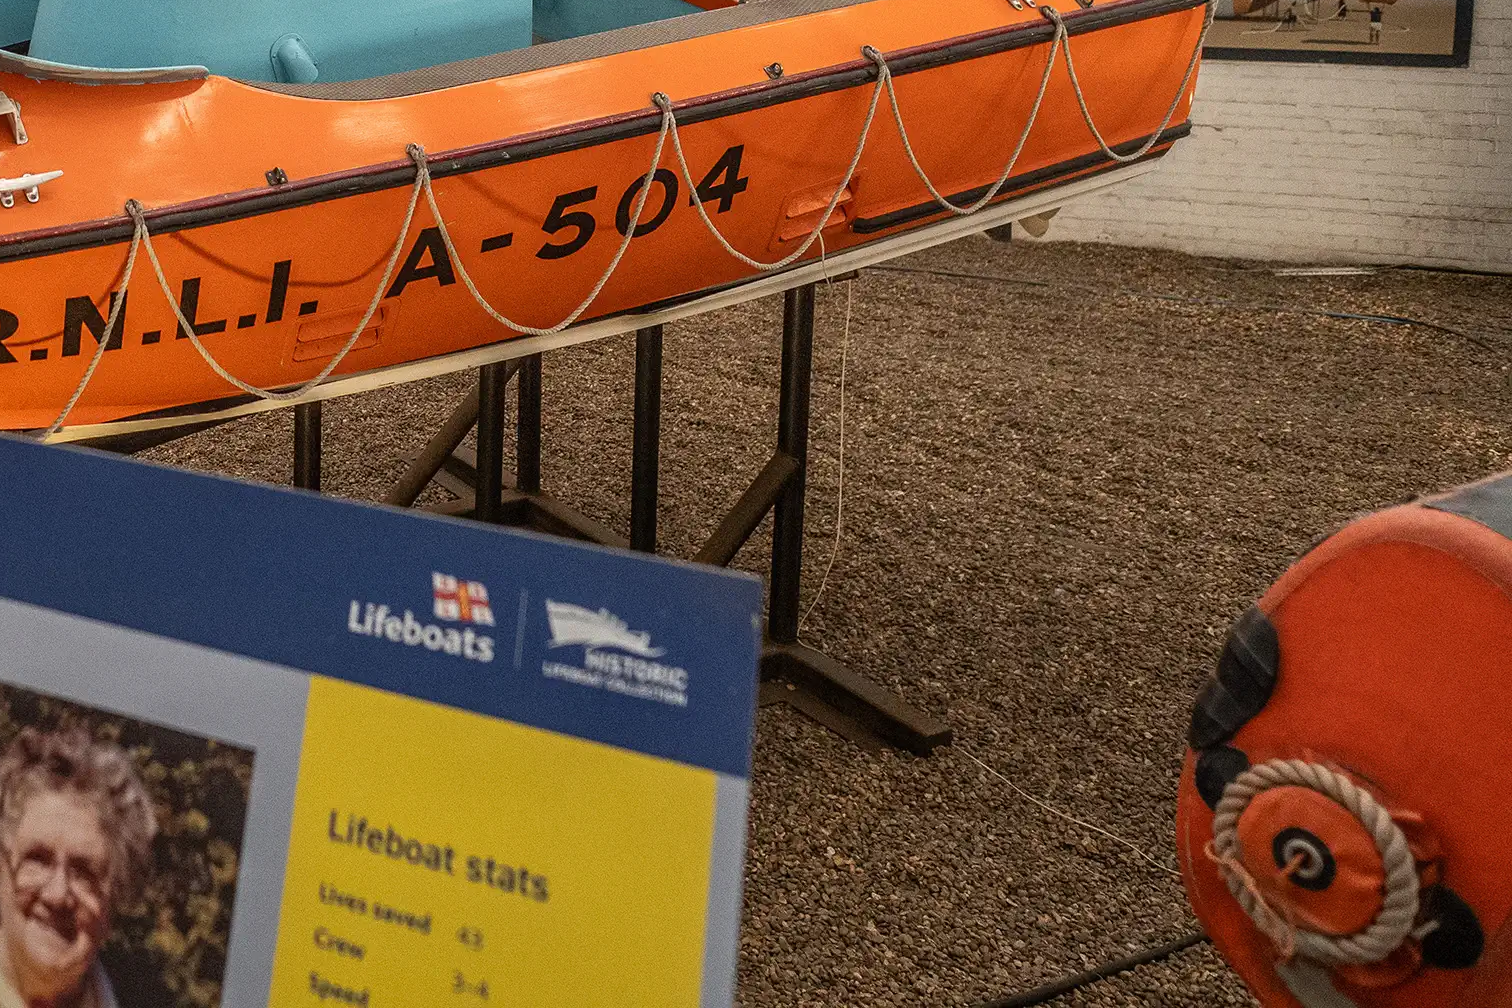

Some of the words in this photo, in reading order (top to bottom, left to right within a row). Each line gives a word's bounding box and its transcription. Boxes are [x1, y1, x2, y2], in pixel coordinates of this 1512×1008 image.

[387, 145, 749, 297] A-504
[348, 601, 495, 662] Lifeboats
[328, 809, 455, 876] Lifeboat
[466, 851, 550, 903] stats
[319, 881, 367, 914] Lives
[373, 902, 432, 936] saved
[313, 927, 365, 960] Crew
